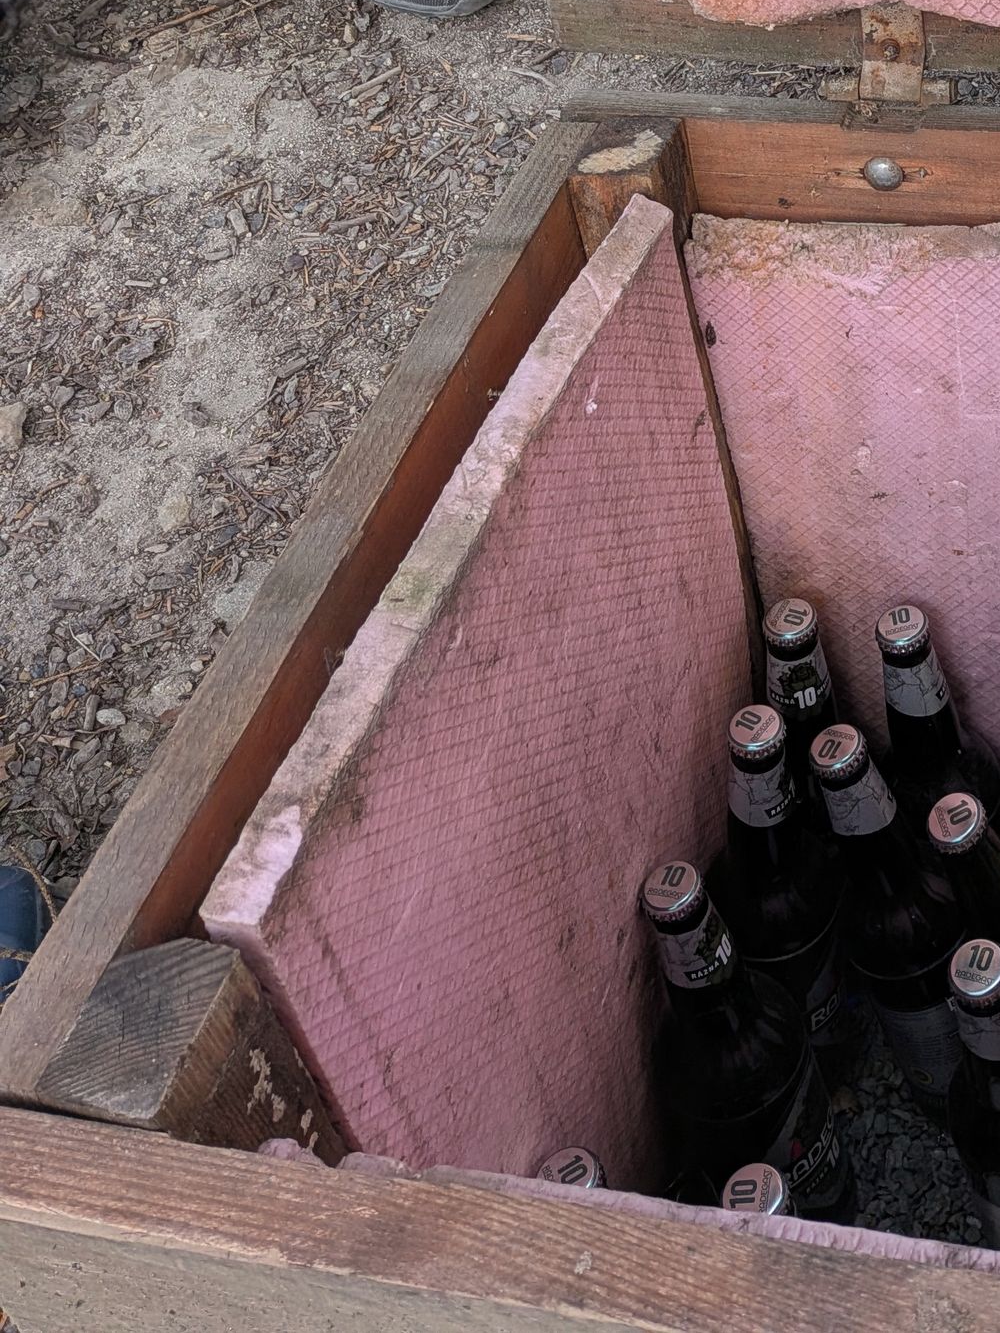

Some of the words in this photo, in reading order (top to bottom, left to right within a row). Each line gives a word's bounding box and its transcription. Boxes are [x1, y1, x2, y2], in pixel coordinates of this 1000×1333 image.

[783, 608, 807, 626] 10
[889, 607, 910, 625] 10
[793, 686, 817, 709] 10
[736, 711, 761, 731] 10
[818, 739, 842, 759] 10
[947, 799, 972, 825] 10
[661, 865, 687, 887] 10
[715, 933, 732, 965] 10
[968, 945, 994, 972] 10
[558, 1155, 587, 1184] 10
[729, 1179, 757, 1208] 10
